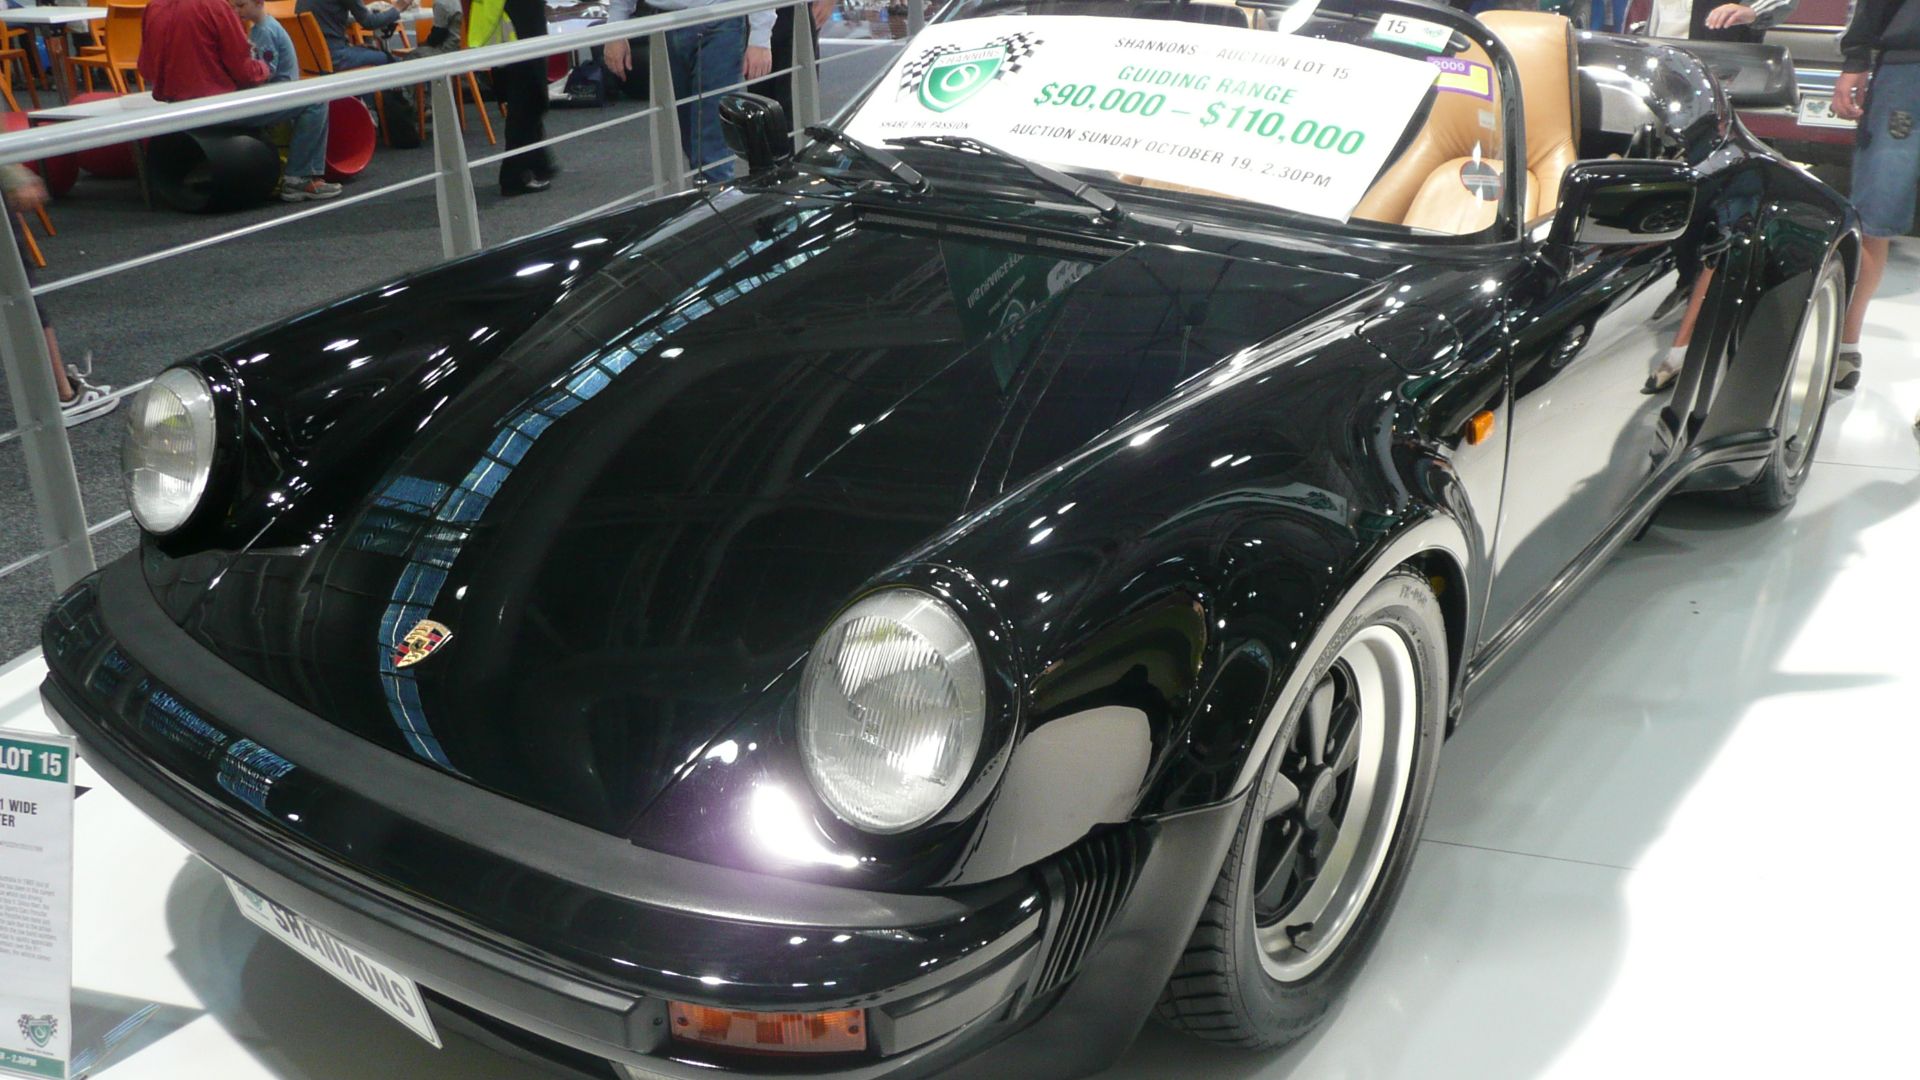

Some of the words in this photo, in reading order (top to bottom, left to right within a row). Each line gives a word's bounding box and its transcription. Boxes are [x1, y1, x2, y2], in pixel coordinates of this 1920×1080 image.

[1386, 19, 1408, 34] 15
[1114, 38, 1199, 56] SHANNONS
[1216, 48, 1289, 67] AUCTION
[1293, 59, 1326, 74] LOT
[1332, 66, 1351, 80] 15
[1117, 64, 1212, 91] GUIDING
[1216, 77, 1299, 105] RANGE
[880, 120, 909, 130] SHARE
[911, 120, 927, 129] THE
[930, 120, 970, 130] PASSION
[1033, 81, 1167, 117] $90,000
[1199, 100, 1366, 155] $110,000
[1009, 123, 1076, 140] AUCTION
[1078, 130, 1142, 150] SUNDAY
[1145, 140, 1225, 164] OCTOBER
[0, 745, 33, 772] LOT
[39, 751, 62, 777] 15
[9, 799, 38, 816] WIDE
[268, 900, 416, 1018] SHANNONS
